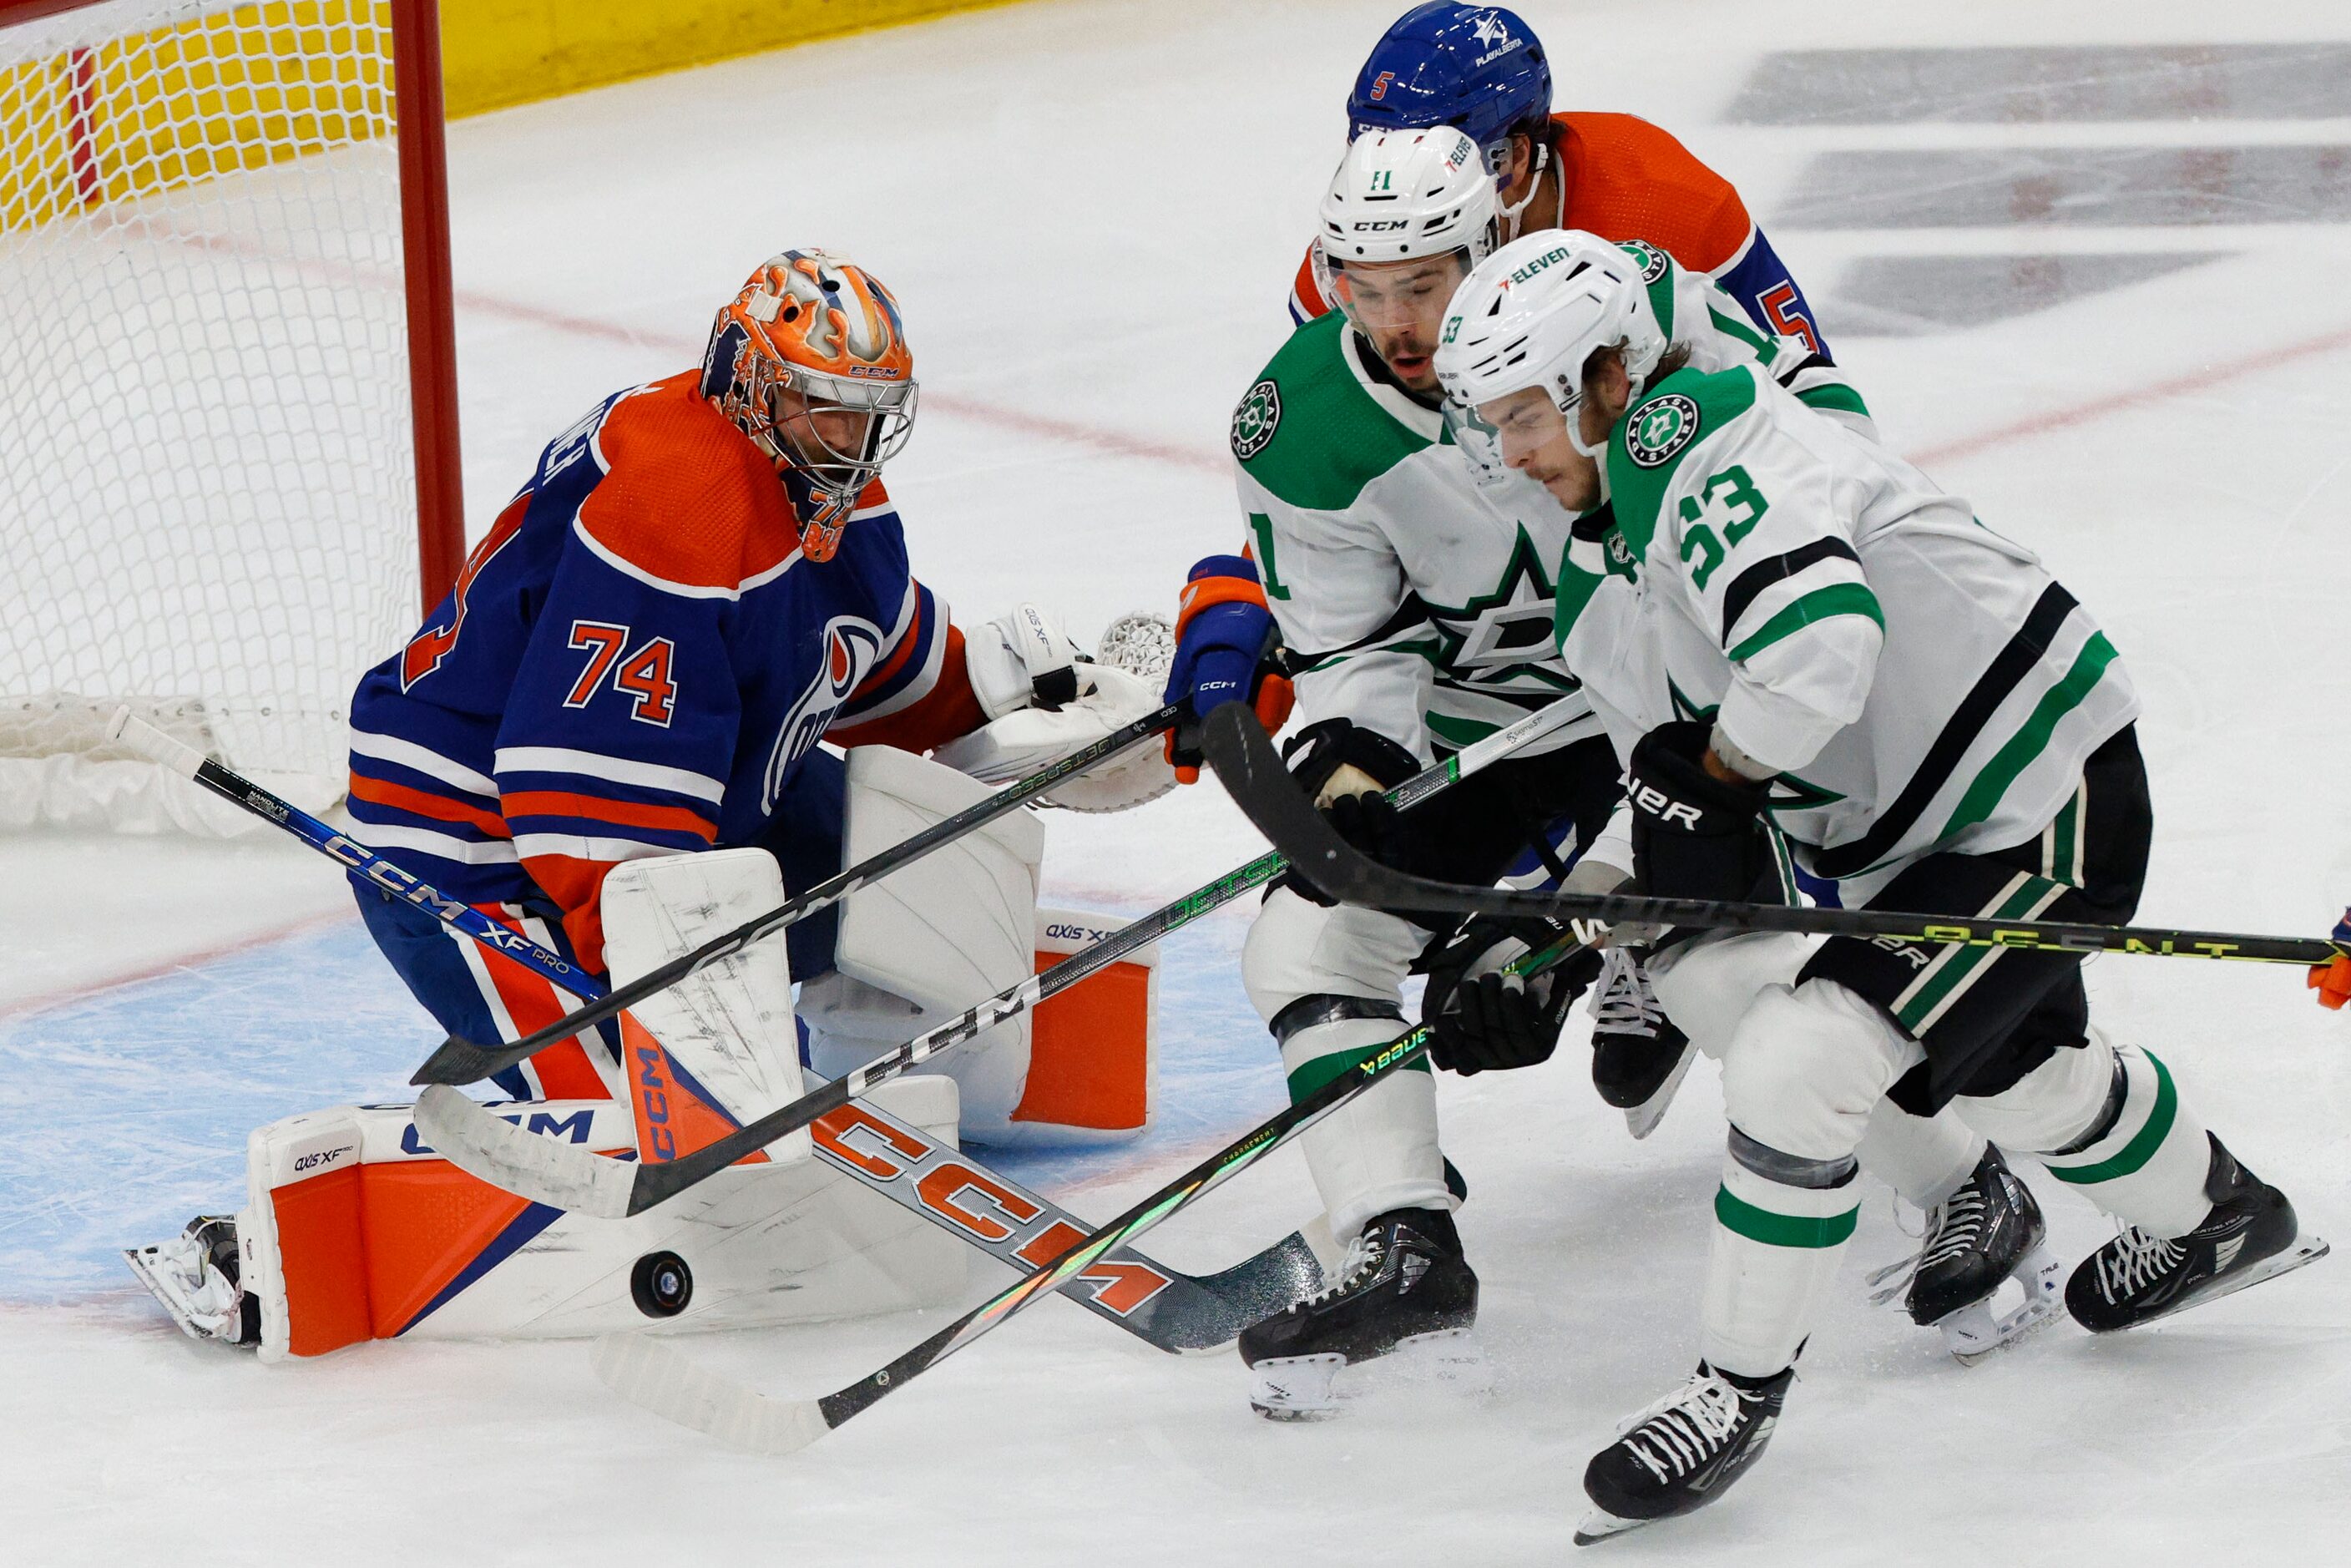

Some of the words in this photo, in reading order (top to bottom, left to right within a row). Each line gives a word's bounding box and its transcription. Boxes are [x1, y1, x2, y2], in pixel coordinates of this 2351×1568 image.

[1370, 71, 1396, 101] 5
[1370, 169, 1392, 191] 11
[1353, 220, 1409, 231] CCM
[1755, 279, 1821, 355] 5
[847, 365, 900, 378] CCM
[1629, 397, 1682, 454] DALLAS
[1647, 410, 1695, 461] STARS
[1679, 464, 1770, 594] 53
[562, 620, 678, 729] 74
[1200, 680, 1236, 692] CCM
[1009, 738, 1111, 800] JETSPEED
[249, 790, 290, 815] NANOLITE
[324, 835, 468, 922] CCM
[478, 920, 533, 951] XF
[531, 948, 571, 975] PRO
[1045, 923, 1085, 940] axis
[636, 1047, 677, 1161] CCM
[294, 1153, 321, 1171] axis
[321, 1150, 342, 1166] XF
